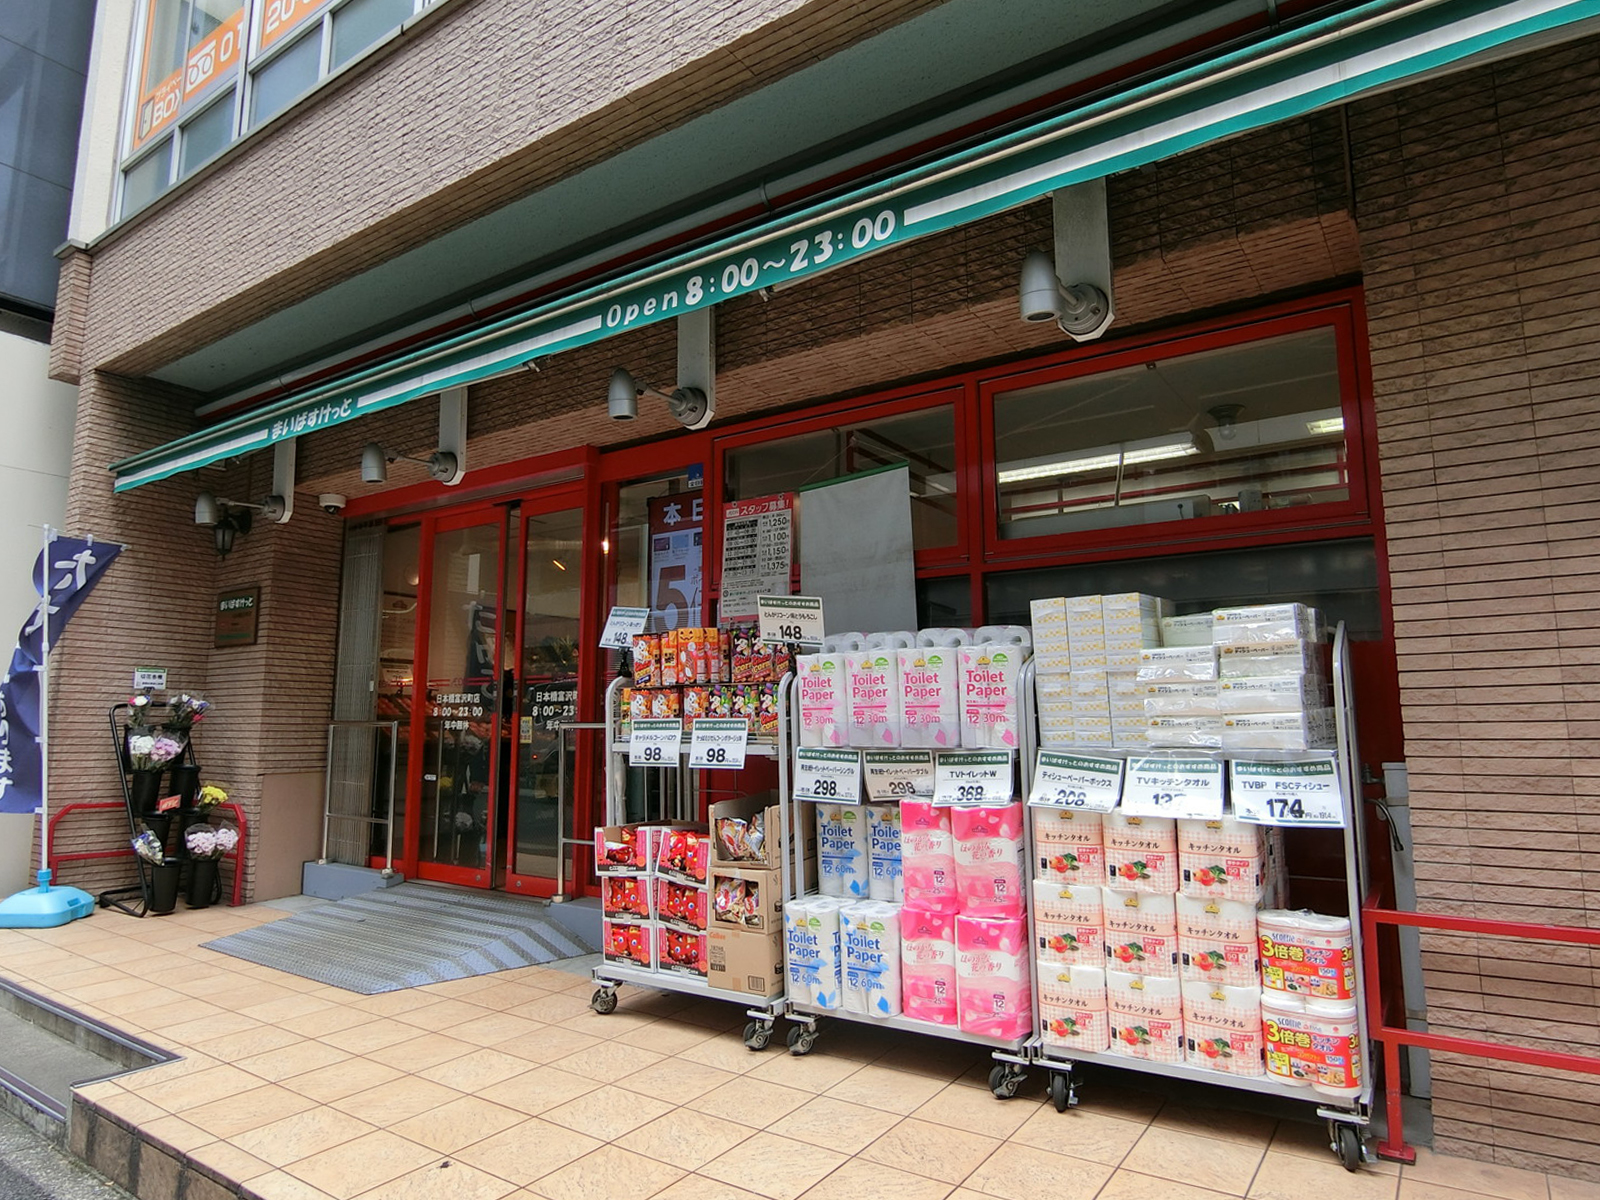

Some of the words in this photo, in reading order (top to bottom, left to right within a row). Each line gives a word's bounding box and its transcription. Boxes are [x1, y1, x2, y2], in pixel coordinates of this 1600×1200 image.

[605, 290, 678, 328] Open
[272, 398, 352, 440] まいばすけっと
[779, 625, 802, 640] 148
[801, 676, 832, 688] Toilet
[852, 674, 886, 685] Toilet
[904, 672, 939, 684] Toilet
[966, 670, 1004, 682] Toilet
[802, 689, 835, 702] Paper
[853, 687, 888, 699] Paper
[905, 685, 942, 698] Paper
[966, 683, 1008, 697] Paper
[804, 716, 813, 725] 12
[855, 715, 865, 724] 12
[907, 714, 917, 724] 12
[968, 714, 980, 724] 12
[644, 747, 662, 761] 98
[706, 748, 726, 763] 98
[1042, 771, 1112, 787] ティシューペーパーボックス
[1137, 776, 1210, 787] TVキッチンタオル
[1242, 781, 1267, 789] TVBP
[1275, 781, 1330, 790] FSCティシュー
[813, 779, 837, 796] 298
[889, 781, 916, 795] 298
[957, 785, 984, 801] 368
[1266, 798, 1305, 818] 174
[821, 825, 853, 837] Toilet
[1045, 832, 1091, 841] キッチンタオル
[821, 837, 855, 851] Paper
[1111, 839, 1160, 849] キッチンタオル
[1188, 843, 1241, 854] キッチンタオル
[823, 865, 832, 874] 12
[874, 867, 883, 876] 12
[1043, 912, 1090, 923] キッチンタオル
[1109, 920, 1157, 932] キッチンタオル
[1186, 926, 1240, 939] キッチンタオル
[788, 929, 818, 946] Toilet
[846, 932, 881, 950] Toilet
[788, 943, 821, 958] Paper
[847, 946, 884, 963] Paper
[1261, 935, 1304, 962] 3倍巻
[791, 972, 801, 983] 12
[849, 977, 859, 988] 12
[1043, 993, 1088, 1007] キッチンタオル
[1114, 1002, 1163, 1016] キッチンタオル
[1192, 1012, 1246, 1028] キッチンタオル
[1266, 1020, 1311, 1048] 3倍巻
